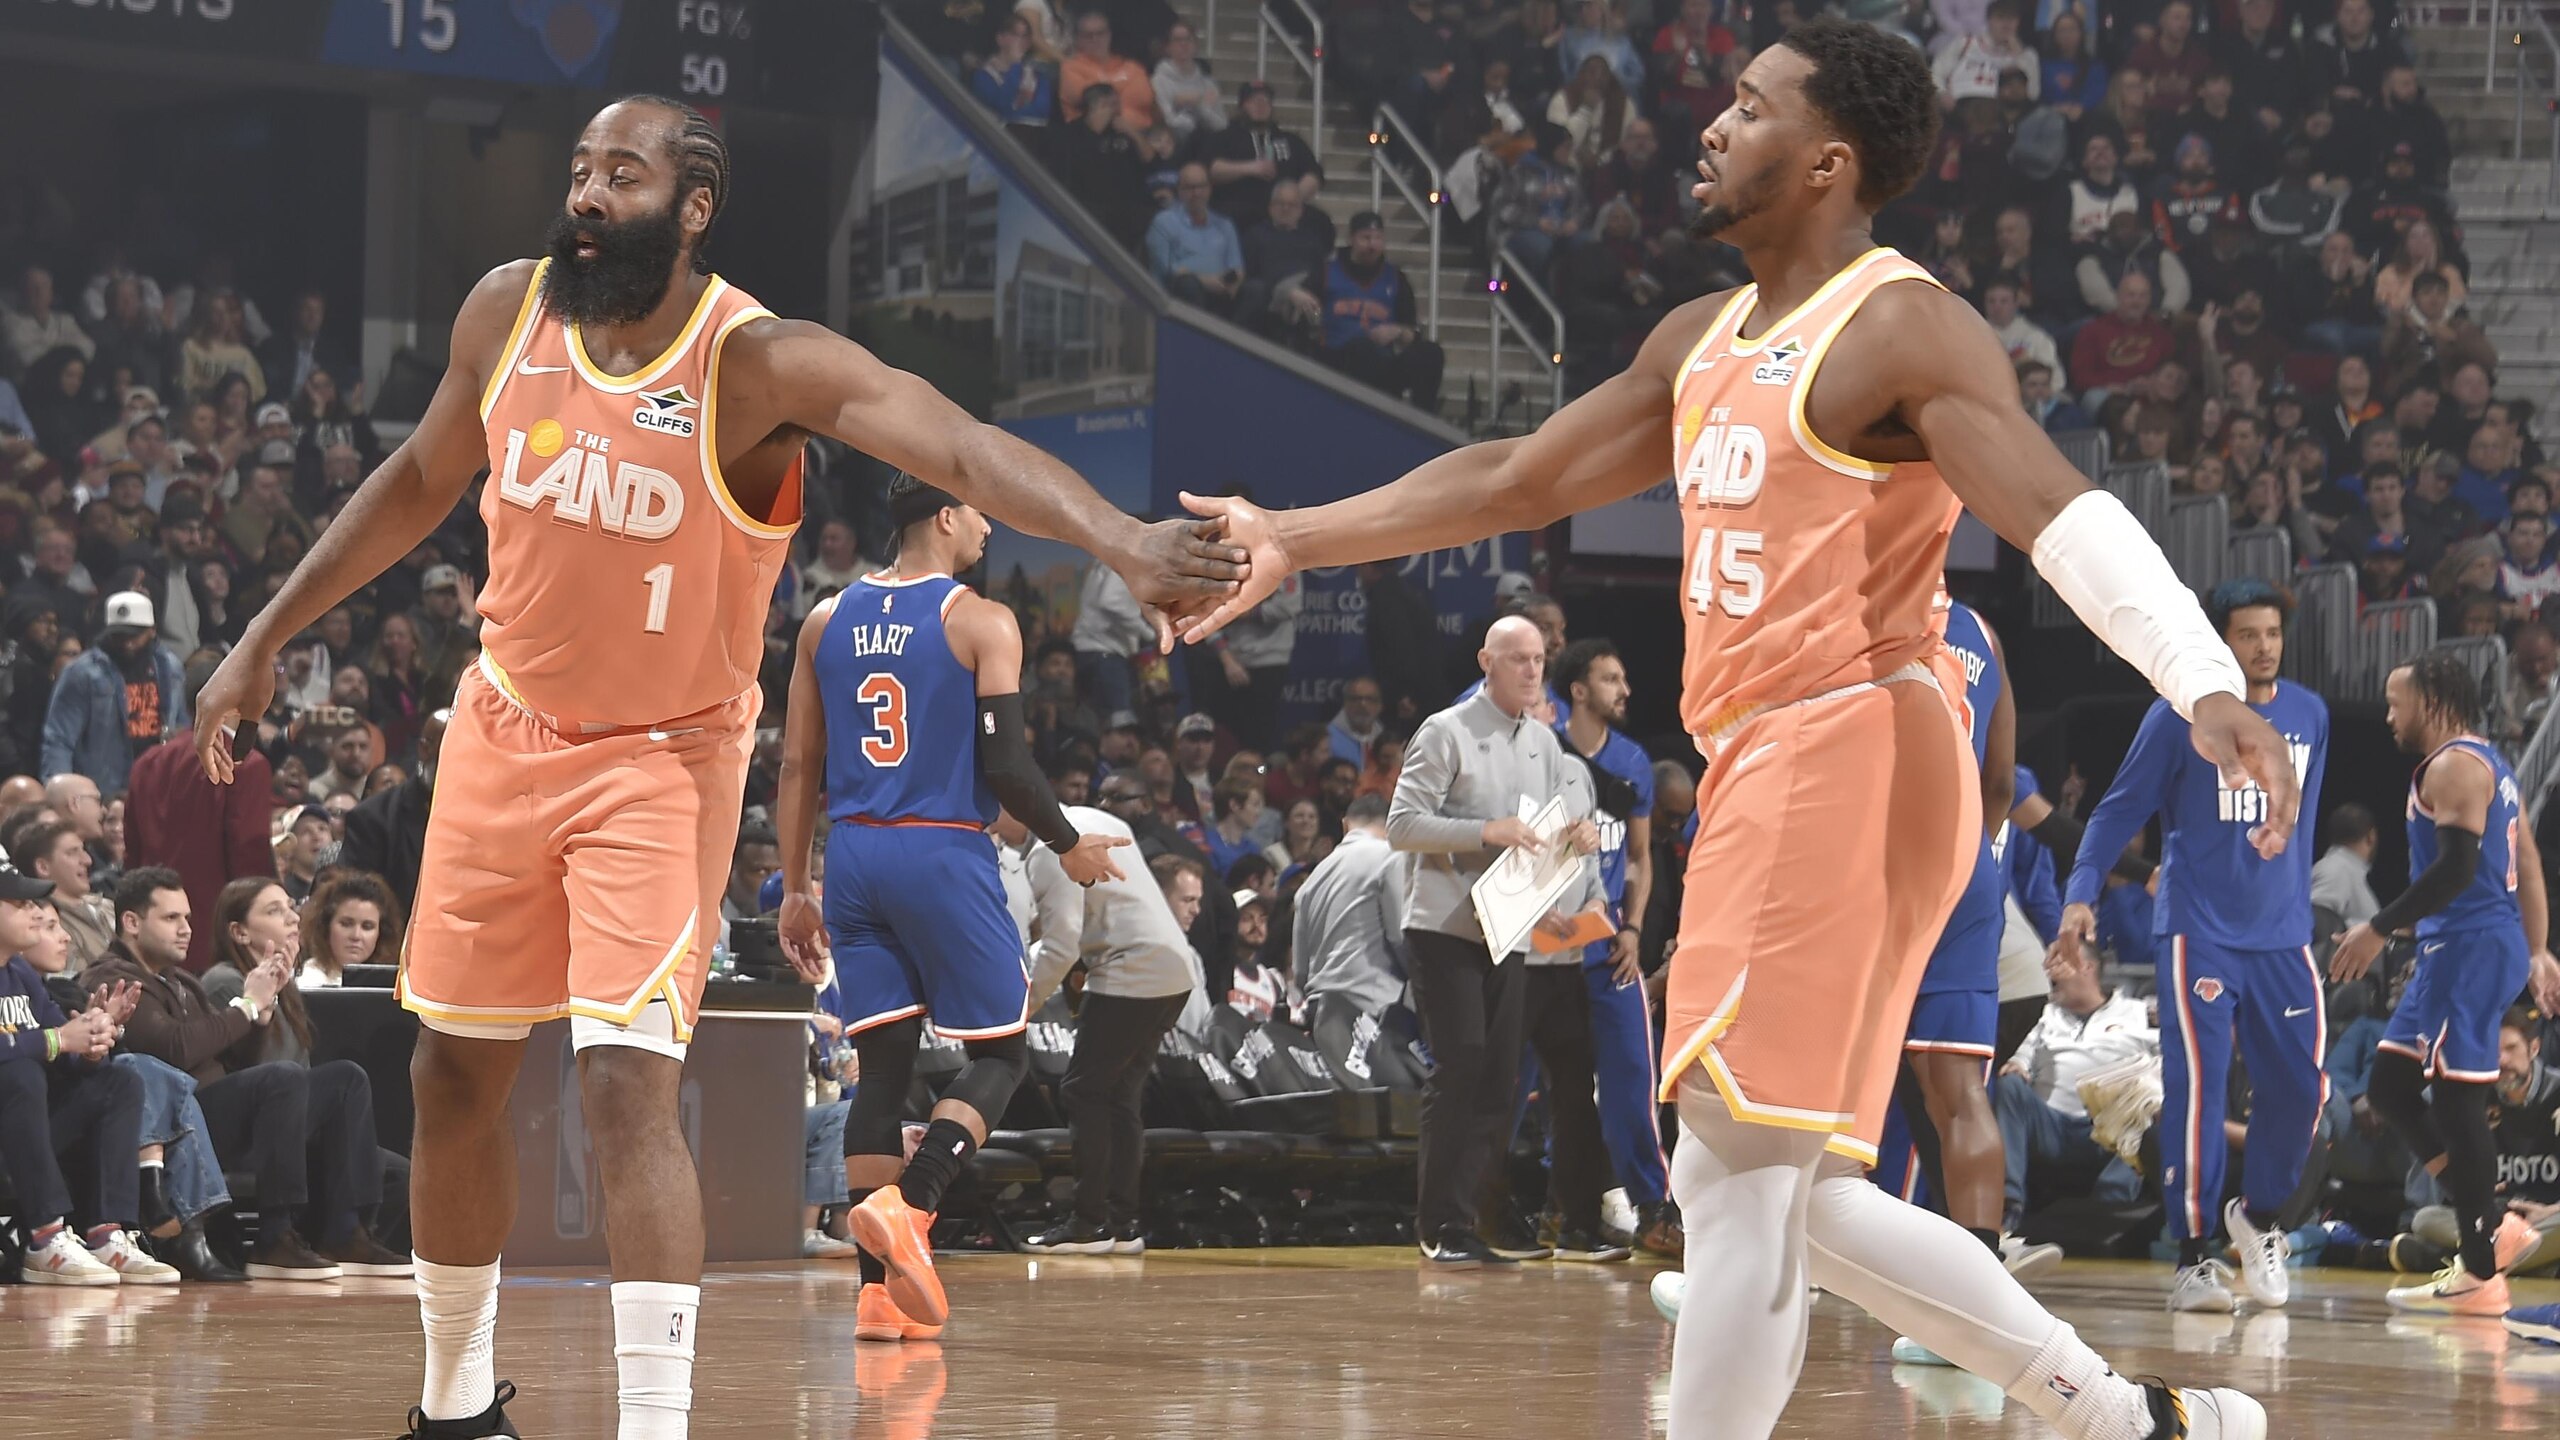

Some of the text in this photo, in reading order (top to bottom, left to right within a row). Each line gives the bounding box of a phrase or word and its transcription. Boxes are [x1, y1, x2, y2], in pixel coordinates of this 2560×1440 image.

[382, 0, 458, 52] 15
[681, 54, 728, 96] 50
[575, 430, 612, 453] THE
[636, 411, 693, 434] CLIFFS
[500, 428, 685, 541] LAND
[1689, 528, 1764, 618] 45
[644, 562, 675, 635] 1
[853, 624, 913, 657] HART
[857, 673, 909, 767] 3
[2497, 1154, 2559, 1184] HOTO
